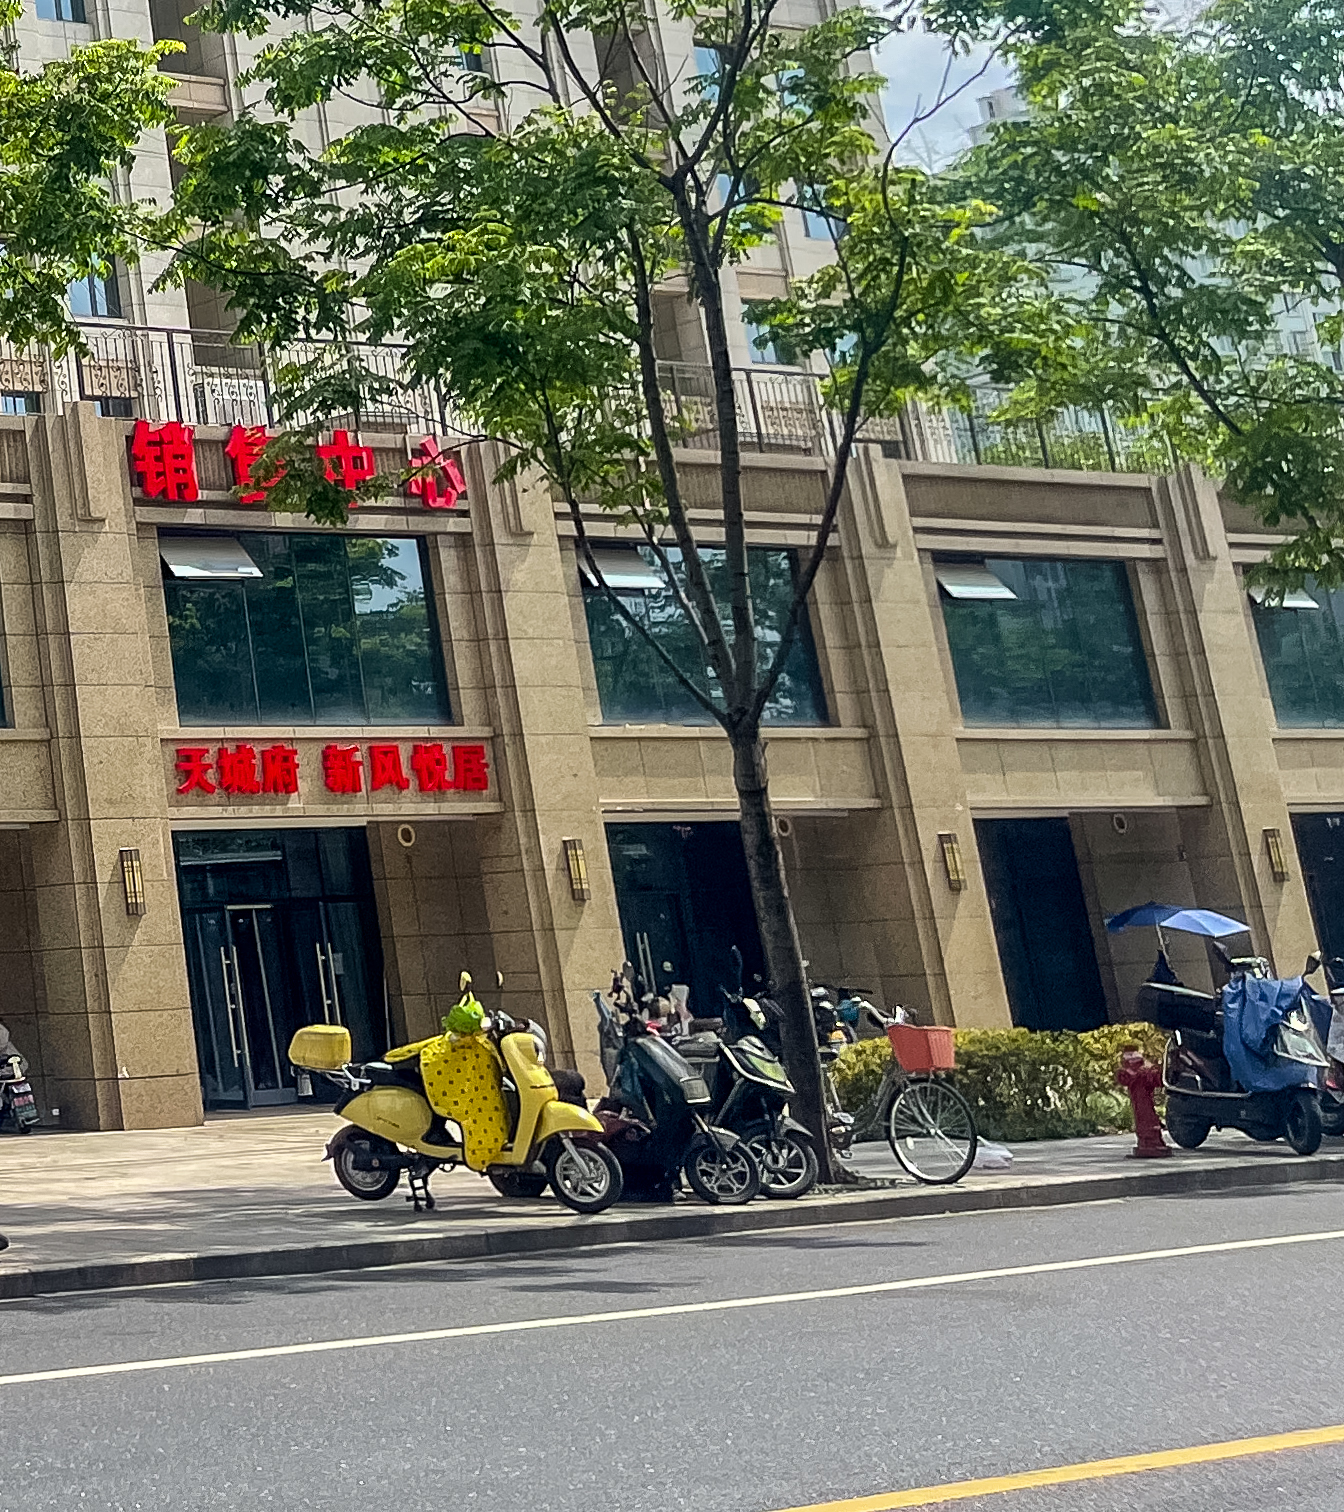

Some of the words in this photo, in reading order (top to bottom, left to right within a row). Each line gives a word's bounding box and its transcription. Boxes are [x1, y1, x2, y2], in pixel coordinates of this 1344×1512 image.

[175, 744, 299, 795] 天城府
[322, 743, 489, 794] 新风悦居
